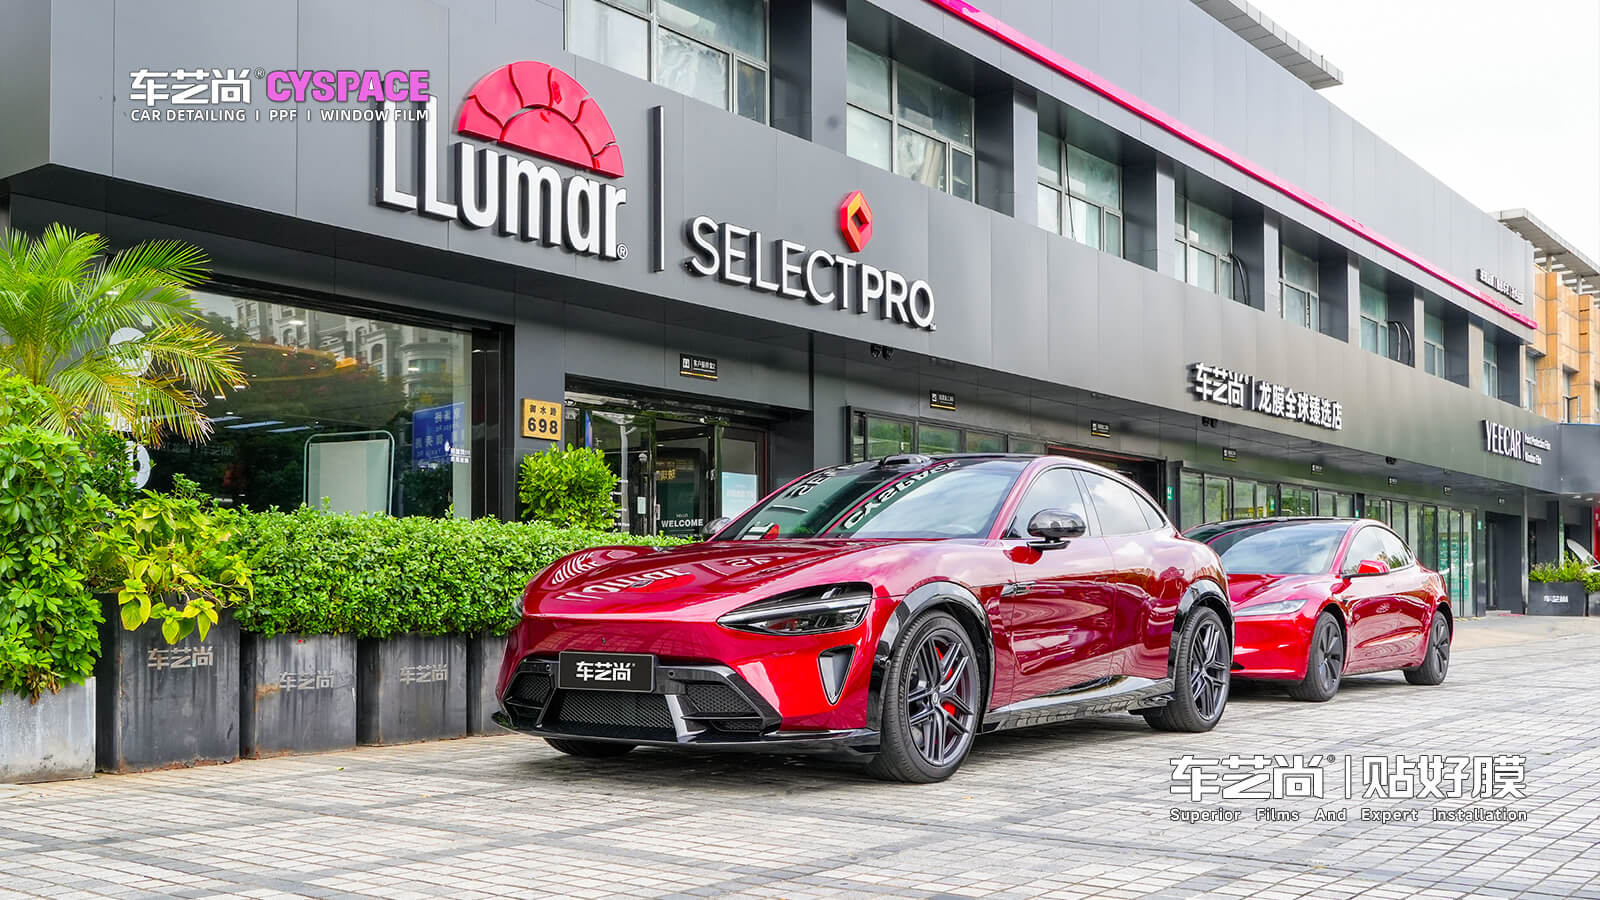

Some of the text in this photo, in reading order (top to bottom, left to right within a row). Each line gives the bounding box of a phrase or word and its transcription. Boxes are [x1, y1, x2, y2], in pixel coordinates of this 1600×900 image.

[1258, 381, 1343, 430] 龙膜全球臻选店
[528, 417, 558, 434] 698
[1485, 419, 1522, 460] YEECAR
[661, 519, 703, 528] WELCOME
[147, 646, 214, 670] 车艺尚
[279, 670, 335, 692] 车艺尚
[399, 664, 448, 685] 车艺尚
[575, 661, 632, 681] 车艺尚
